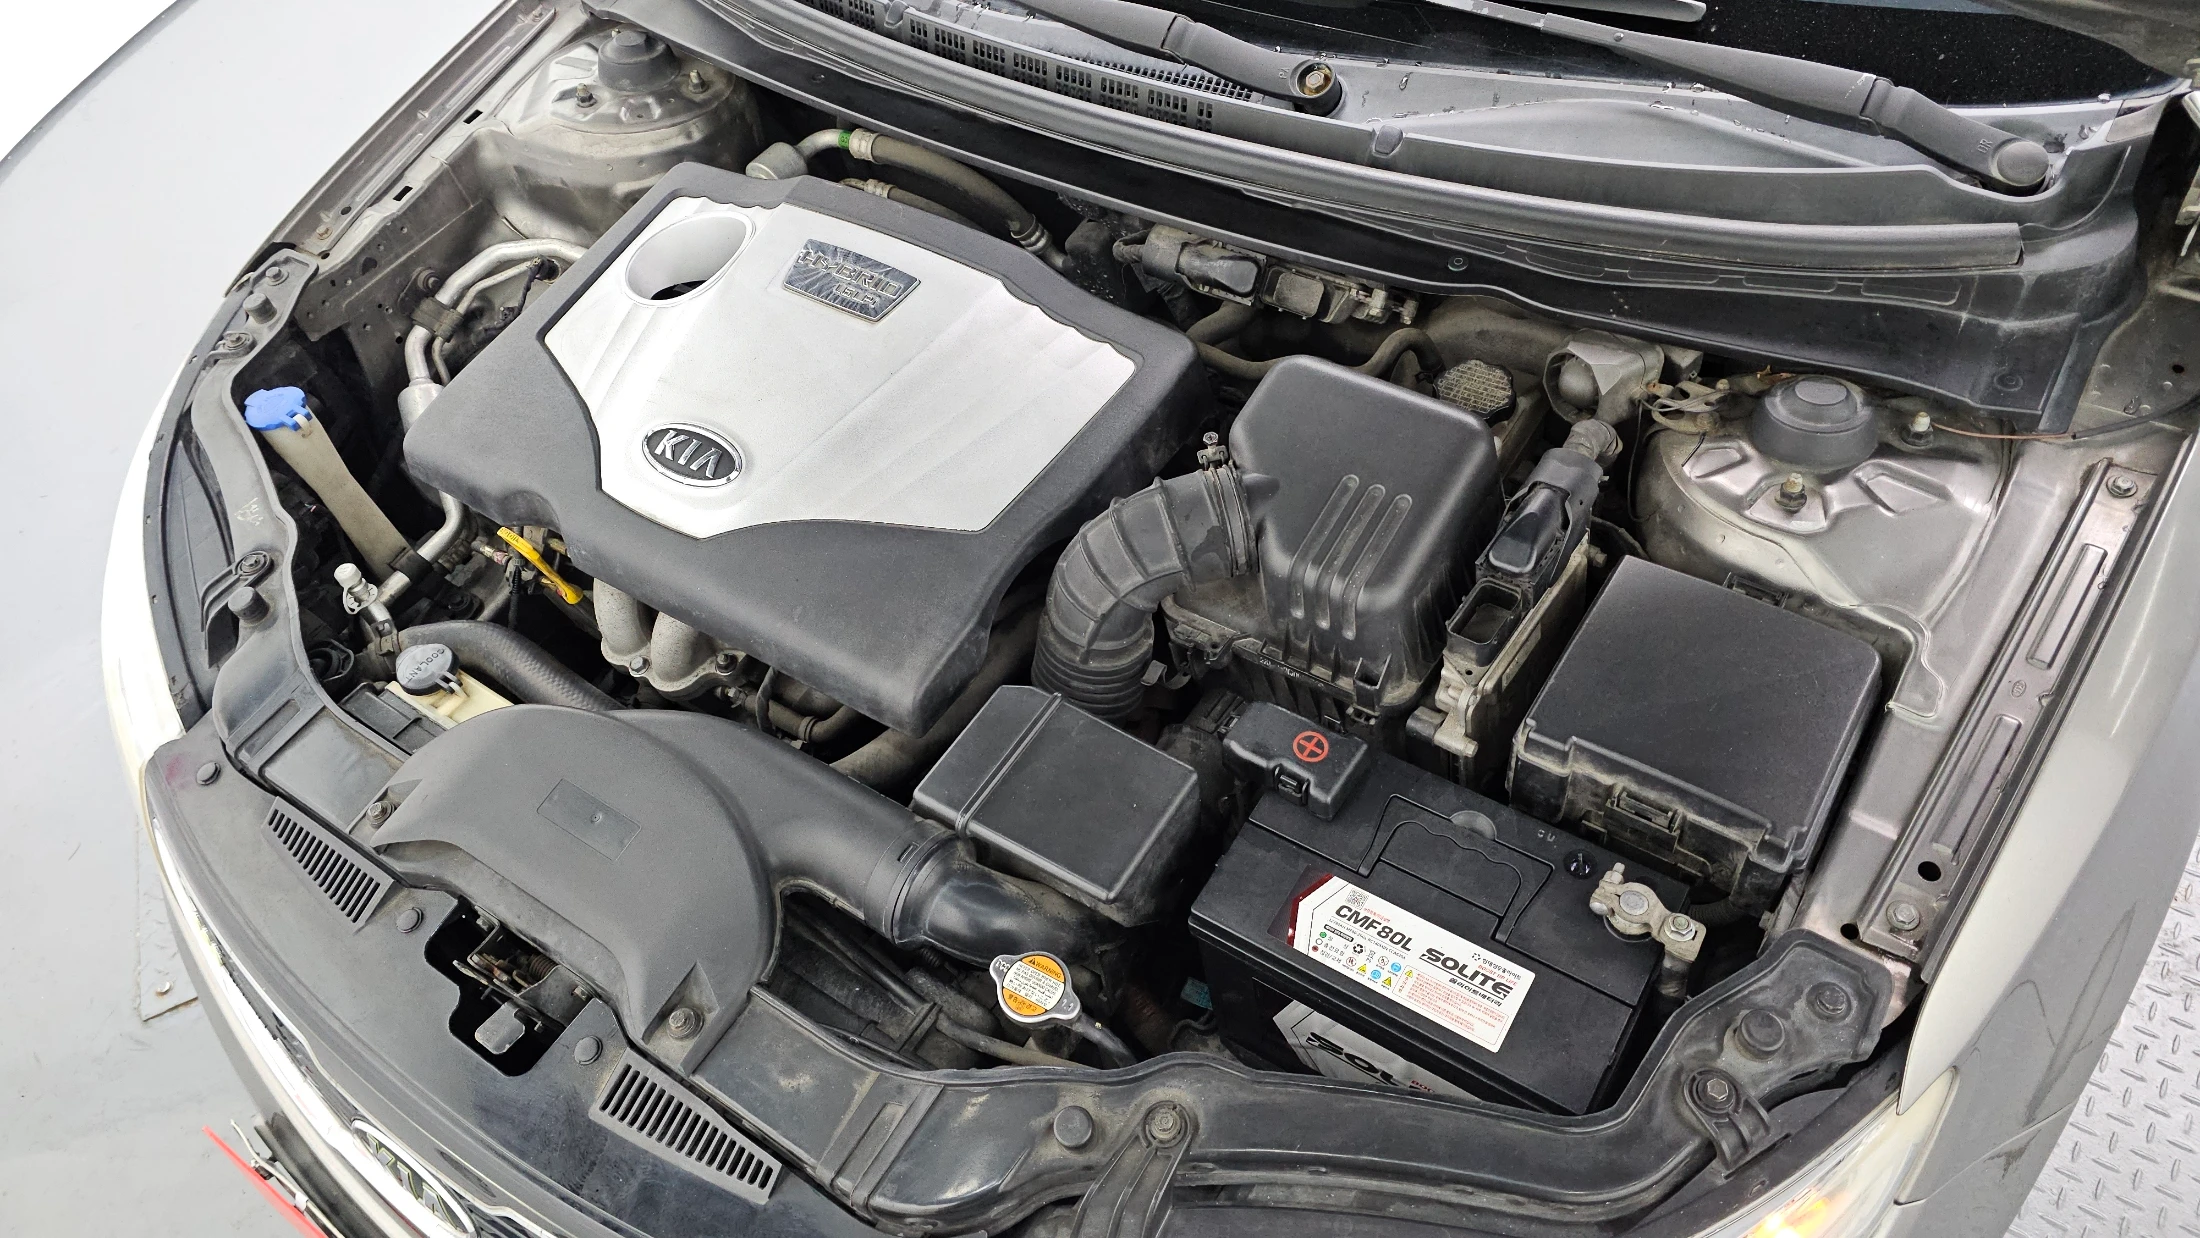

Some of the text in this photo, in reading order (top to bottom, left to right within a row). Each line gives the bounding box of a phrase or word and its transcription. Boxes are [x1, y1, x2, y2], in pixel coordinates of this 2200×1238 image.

[796, 248, 904, 298] HYBRID
[653, 429, 725, 479] KIA
[404, 647, 446, 683] COOLANT
[1335, 904, 1414, 952] CMF80L
[1035, 961, 1061, 979] WARNING
[1420, 947, 1514, 999] SOLITE
[1505, 977, 1518, 986] LIFE
